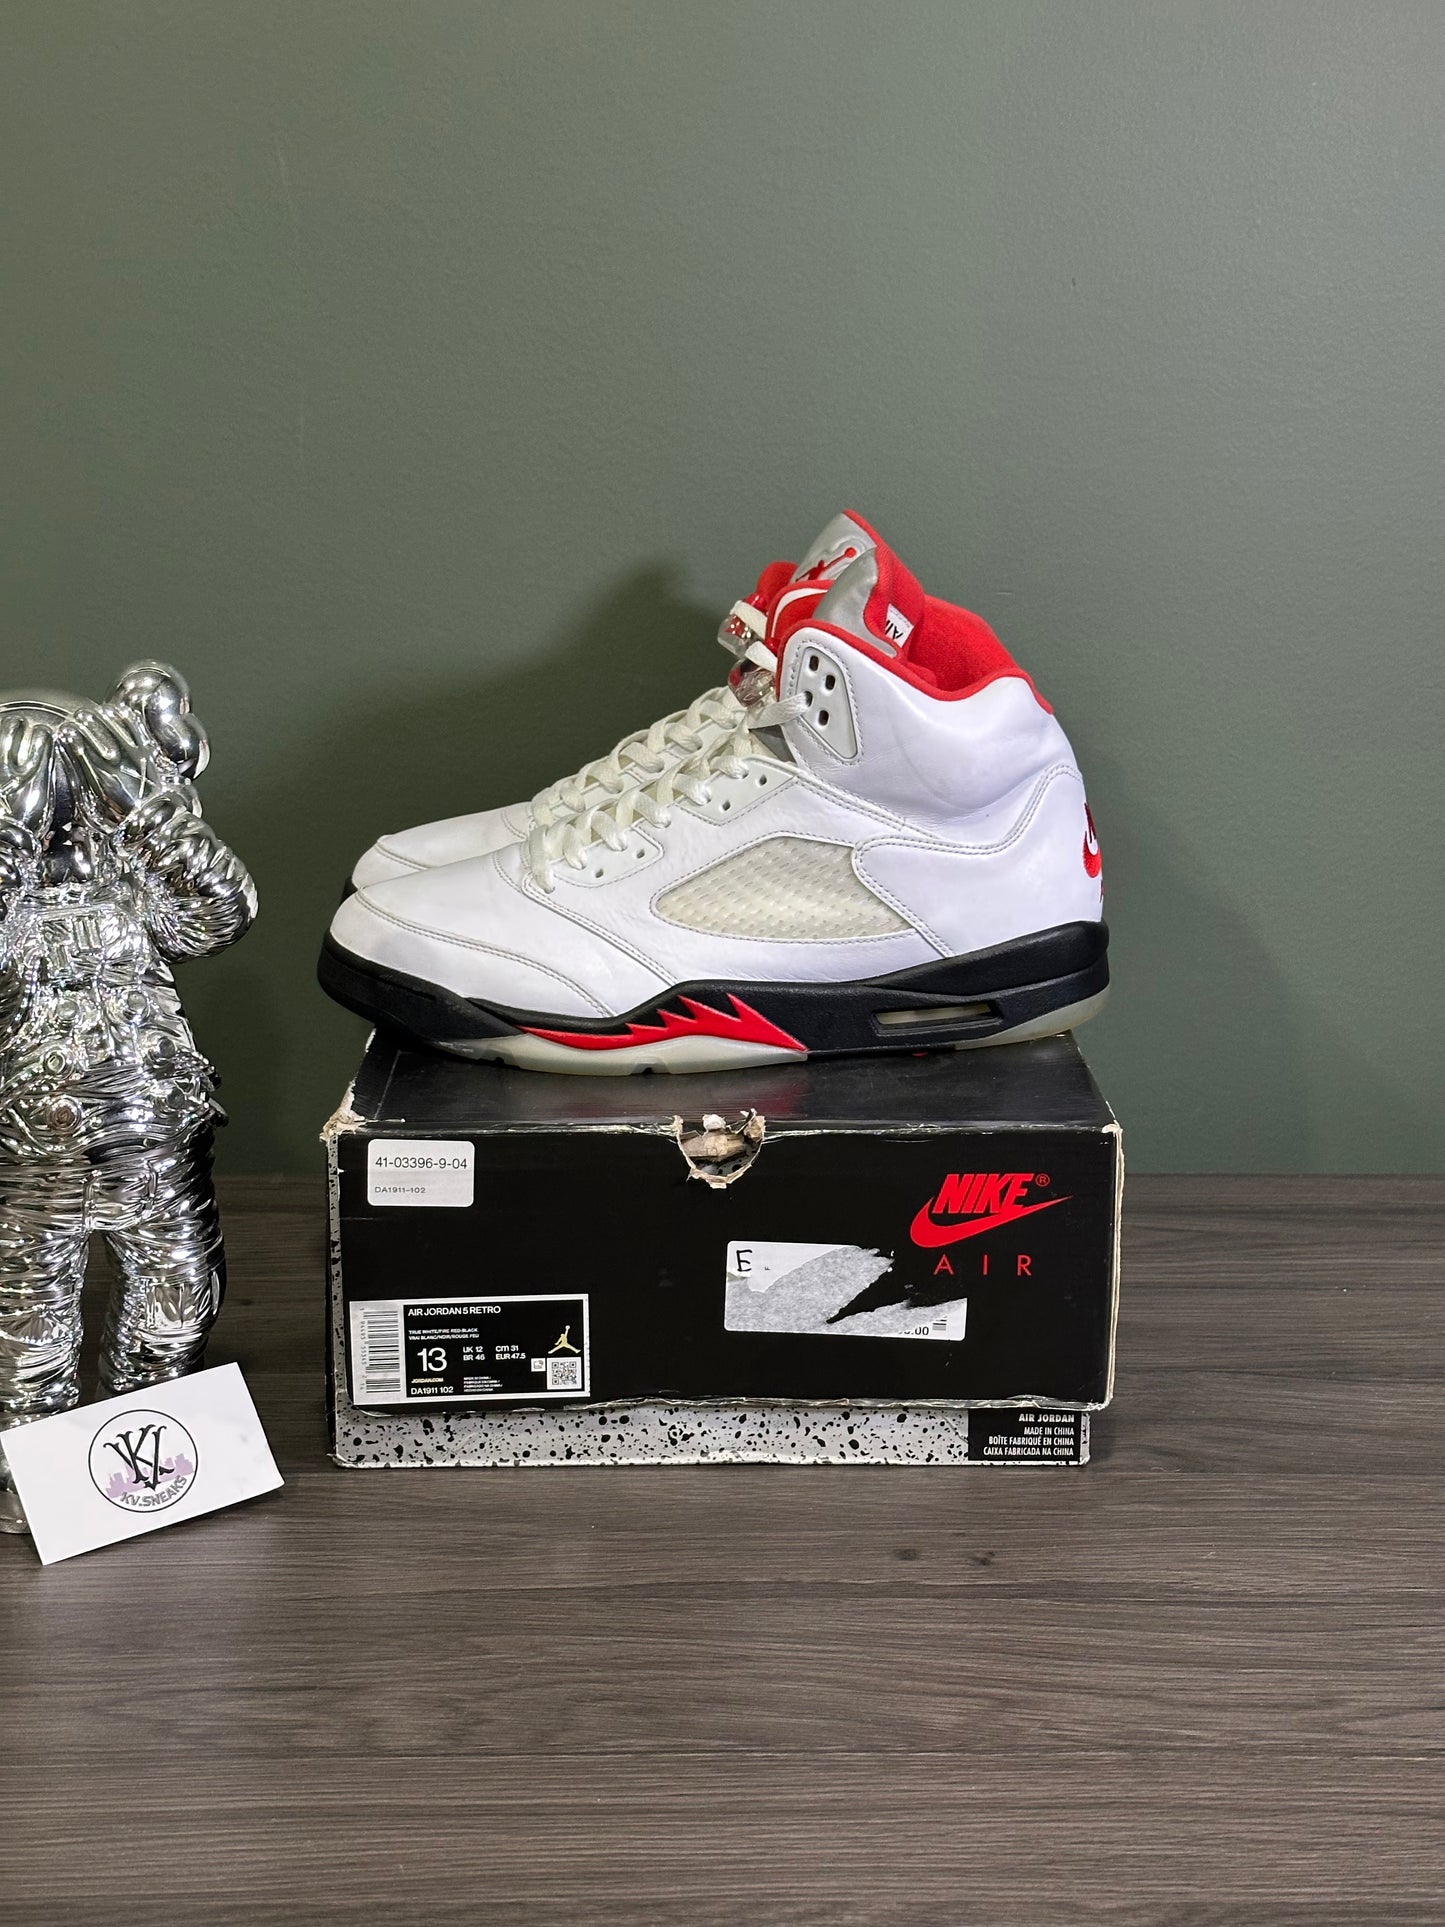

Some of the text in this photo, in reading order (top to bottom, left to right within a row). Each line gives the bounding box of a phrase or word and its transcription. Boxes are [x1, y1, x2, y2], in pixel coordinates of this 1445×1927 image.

[885, 619, 903, 639] AI
[375, 1156, 468, 1169] 41-03396-9-04
[374, 1186, 426, 1194] DA1911-102
[736, 1249, 753, 1272] E
[933, 1253, 1032, 1276] AIR
[407, 1305, 501, 1317] AIR JORDAN 5 RETRO
[475, 1345, 484, 1353] 12
[510, 1344, 519, 1352] 31
[417, 1346, 448, 1372] 13
[510, 1352, 526, 1360] 47.5
[410, 1387, 438, 1395] DA1911
[1018, 1413, 1075, 1423] AIR JORDAN
[1023, 1427, 1075, 1436] MADE IN CHINA
[1009, 1436, 1041, 1446] FABRIQUÉ
[1043, 1437, 1052, 1446] EN
[1053, 1437, 1074, 1446] CHINA
[983, 1446, 1074, 1456] CAIXA FABRICADA NA CHINA
[120, 1475, 187, 1507] KV.SNEAKS
